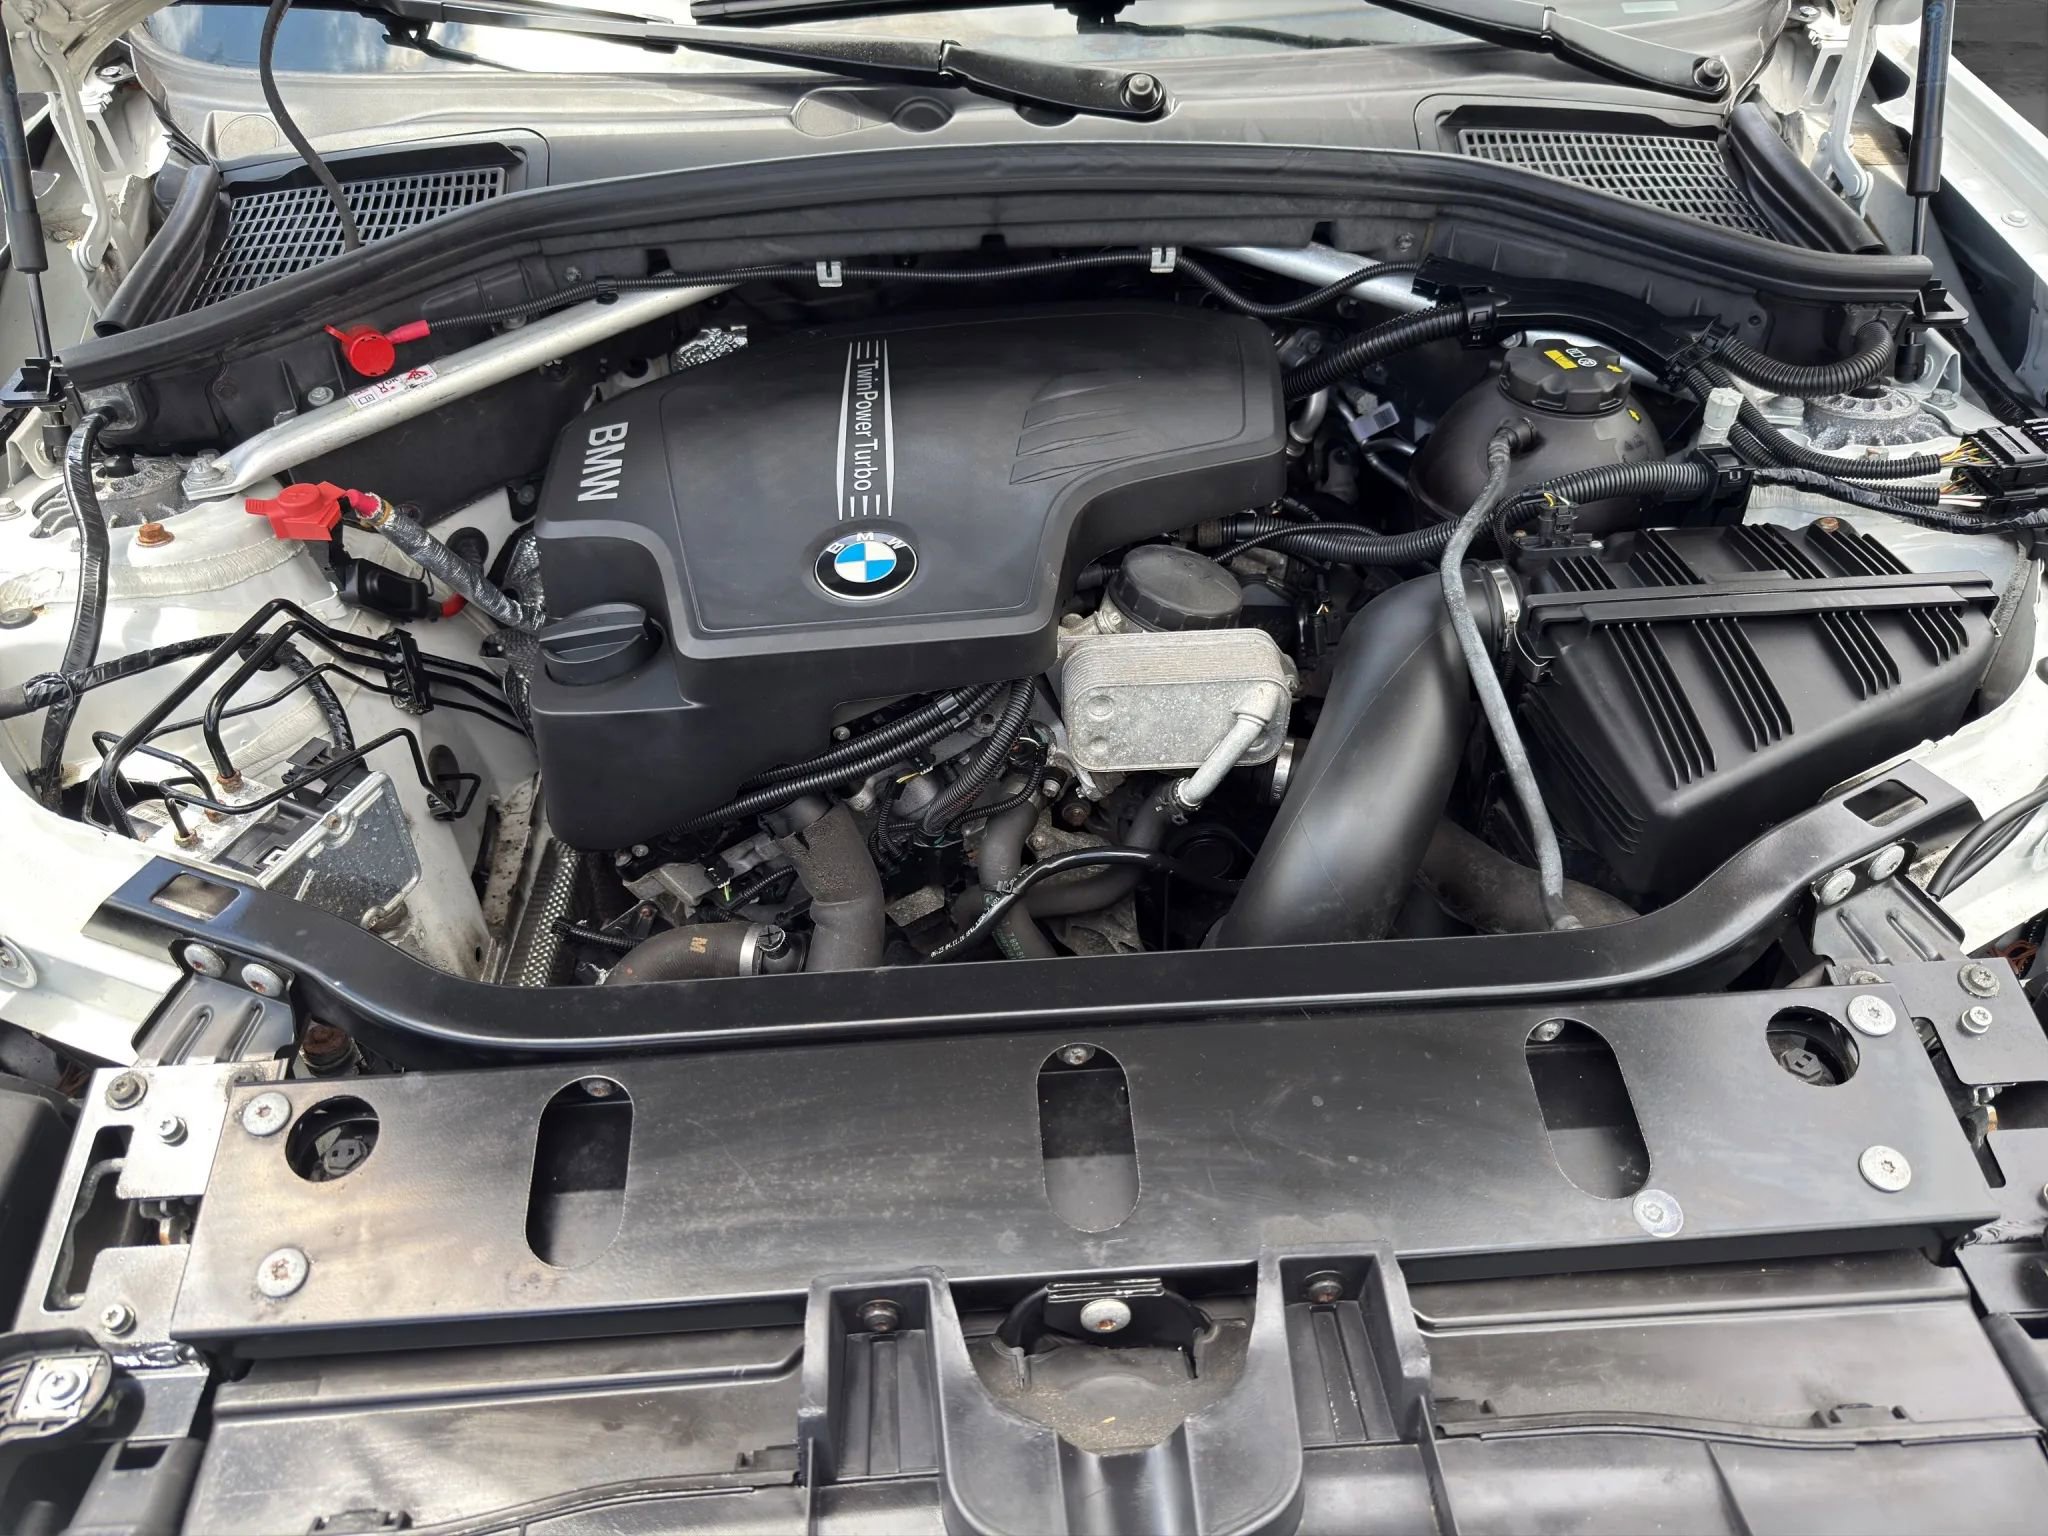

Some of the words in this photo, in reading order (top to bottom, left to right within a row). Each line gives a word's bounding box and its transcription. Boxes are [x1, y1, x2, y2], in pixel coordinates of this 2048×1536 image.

[854, 360, 879, 437] TwinPower
[577, 421, 629, 502] BMW
[854, 438, 879, 491] Turbo
[826, 532, 907, 554] BMW
